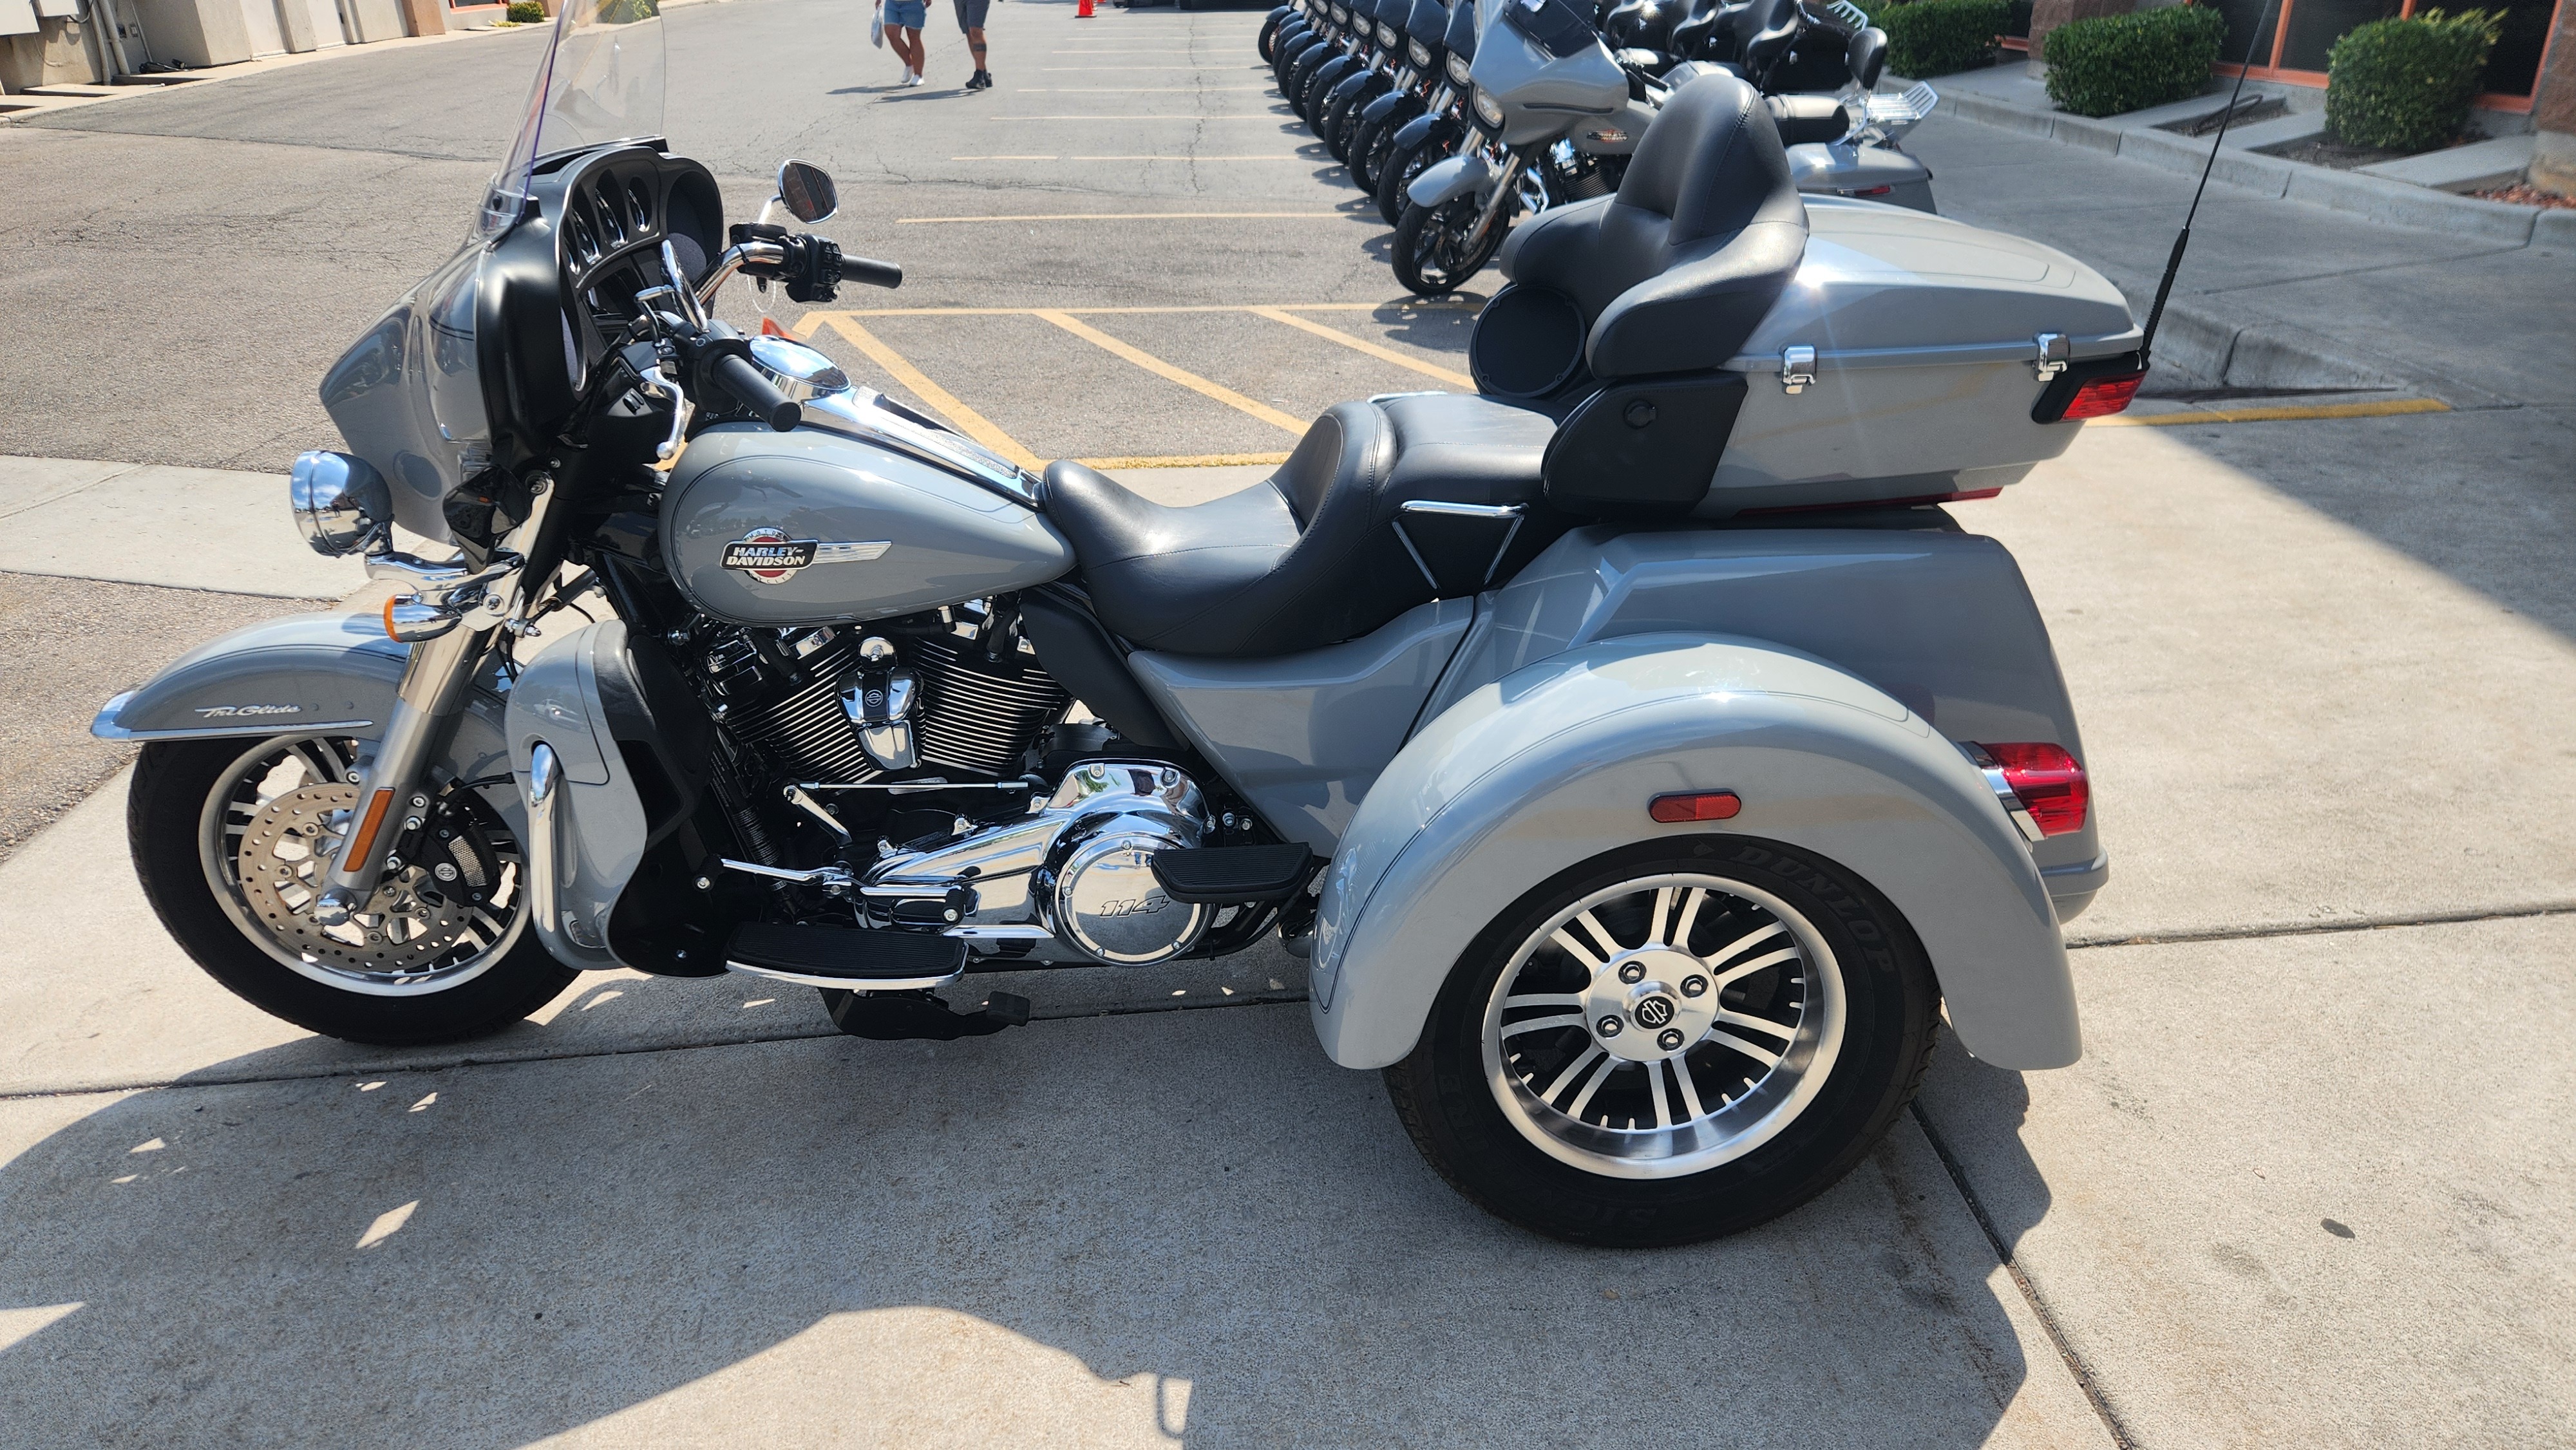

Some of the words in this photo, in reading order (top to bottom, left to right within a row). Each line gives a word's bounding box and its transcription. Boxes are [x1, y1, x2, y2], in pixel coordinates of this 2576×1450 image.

[733, 547, 804, 556] HARLEY-
[726, 556, 806, 565] DAVIDSON
[1100, 895, 1170, 918] 114
[1732, 846, 1895, 972] DUNLOP
